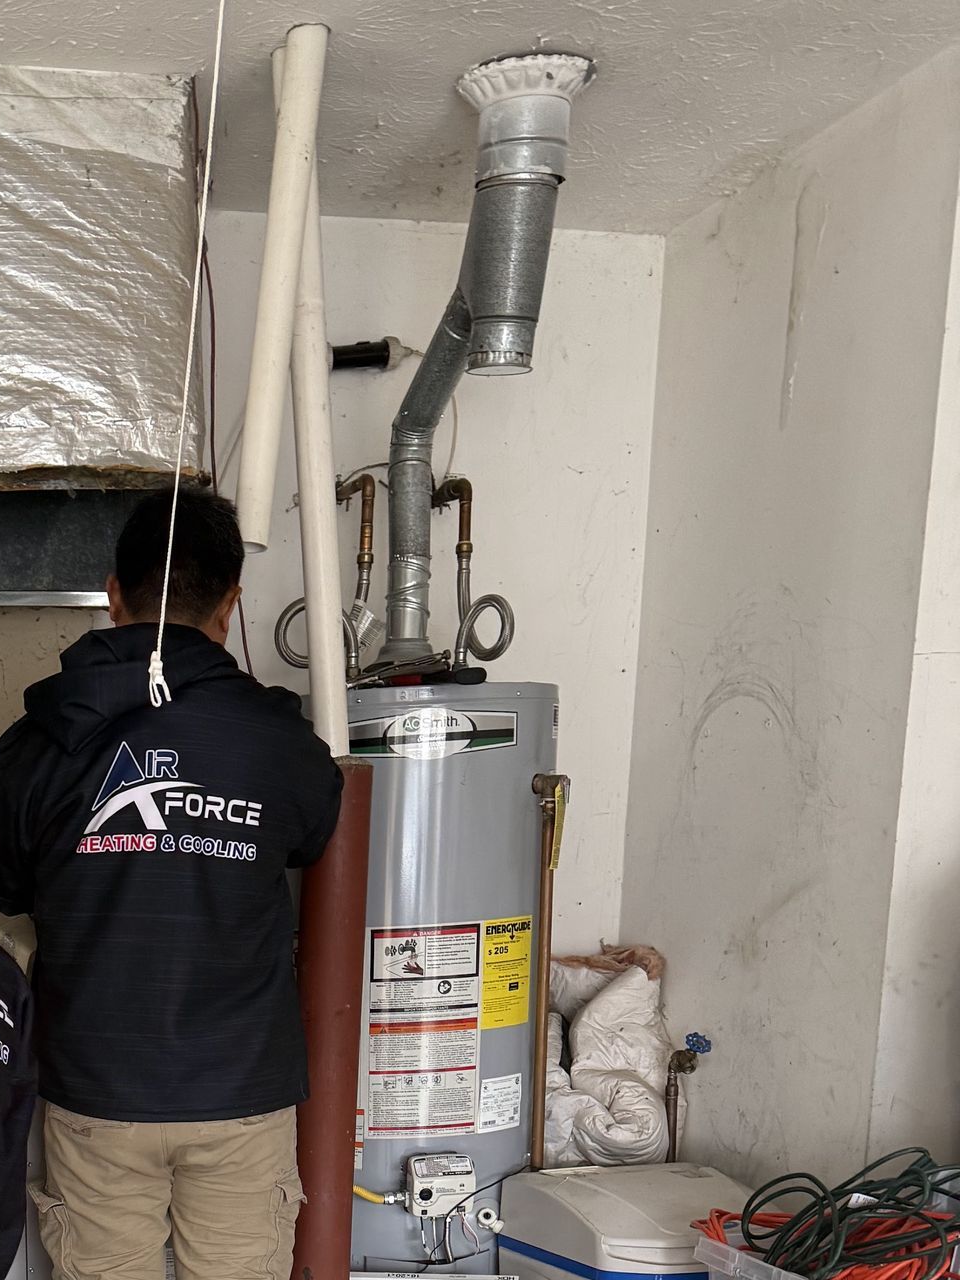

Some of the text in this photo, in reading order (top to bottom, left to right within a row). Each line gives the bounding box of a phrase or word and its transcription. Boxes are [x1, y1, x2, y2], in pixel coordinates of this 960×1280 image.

[90, 740, 179, 815] AIR
[164, 791, 262, 826] FORCE
[76, 833, 257, 861] HEATING & COOLING
[494, 945, 509, 955] 205
